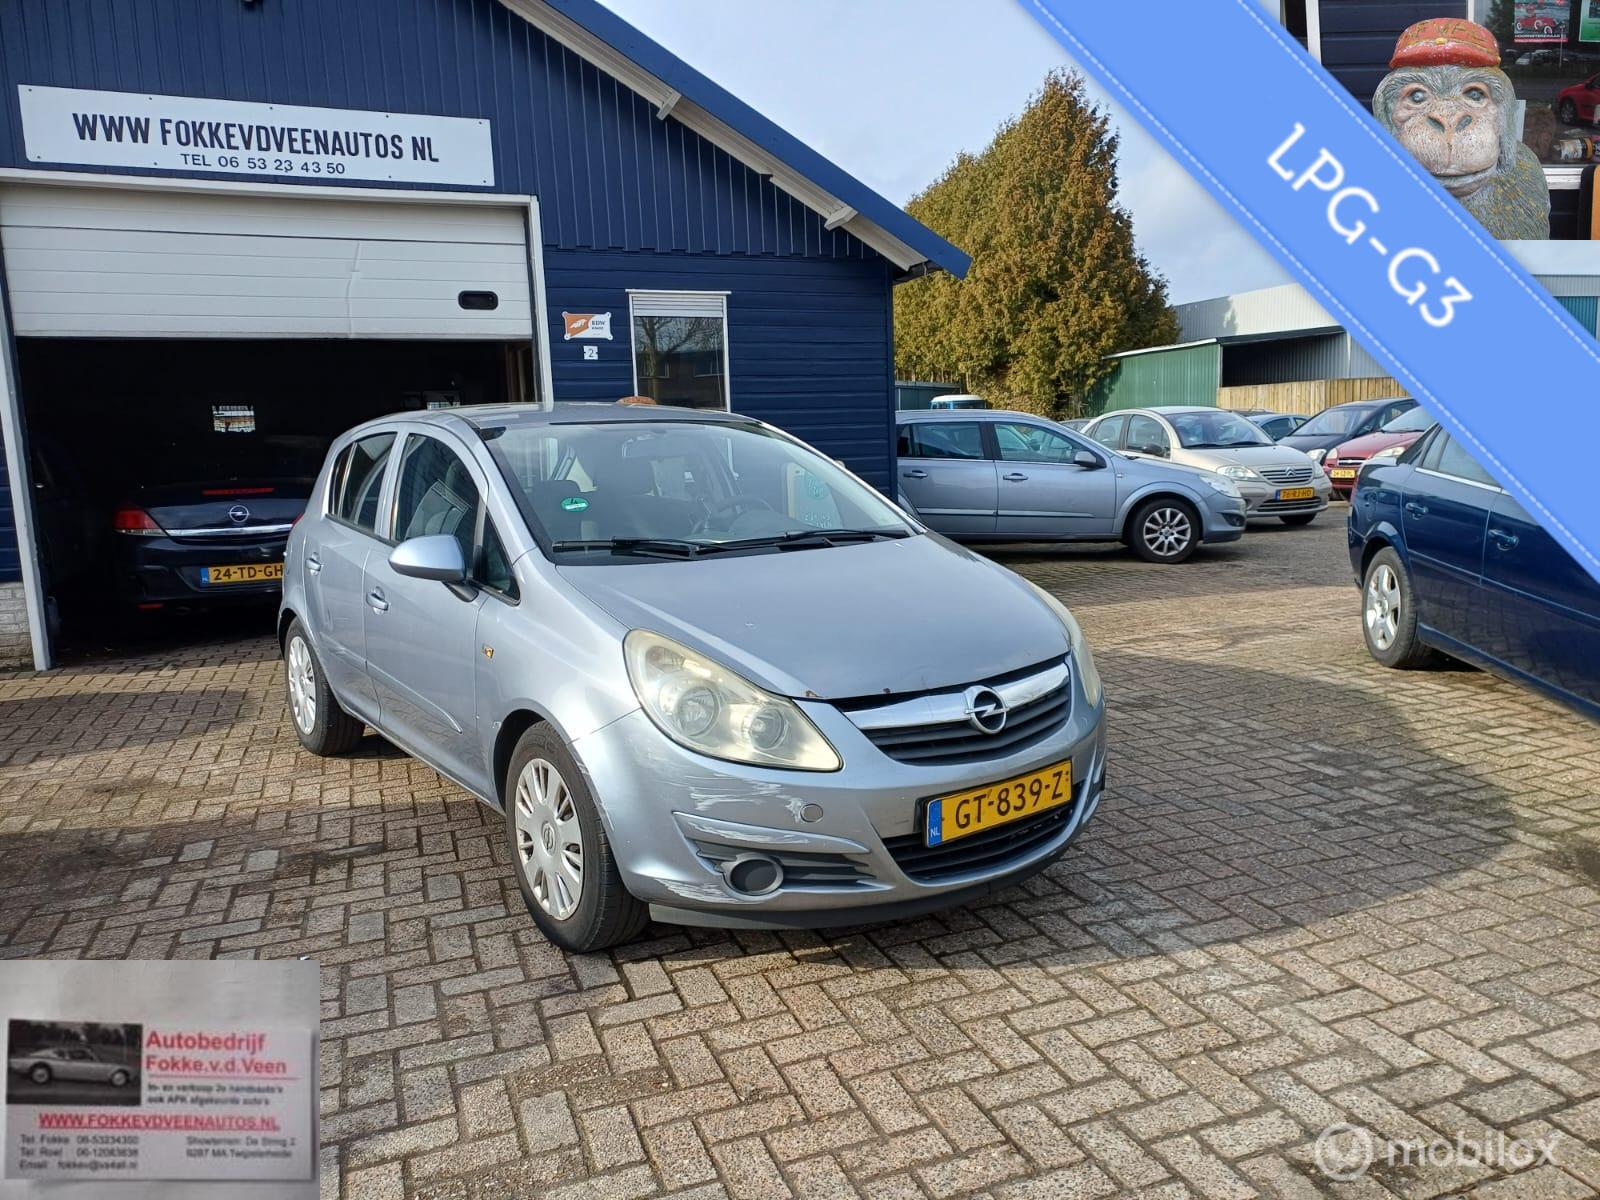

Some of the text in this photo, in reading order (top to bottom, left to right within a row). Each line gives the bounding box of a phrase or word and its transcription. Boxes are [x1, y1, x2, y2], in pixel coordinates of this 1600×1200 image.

[411, 135, 440, 163] NL
[180, 152, 346, 175] TEL 06 53 23 43 50
[588, 348, 594, 358] 2
[212, 564, 283, 581] 24-TD-GH
[930, 770, 1064, 837] NL GT-839-Z
